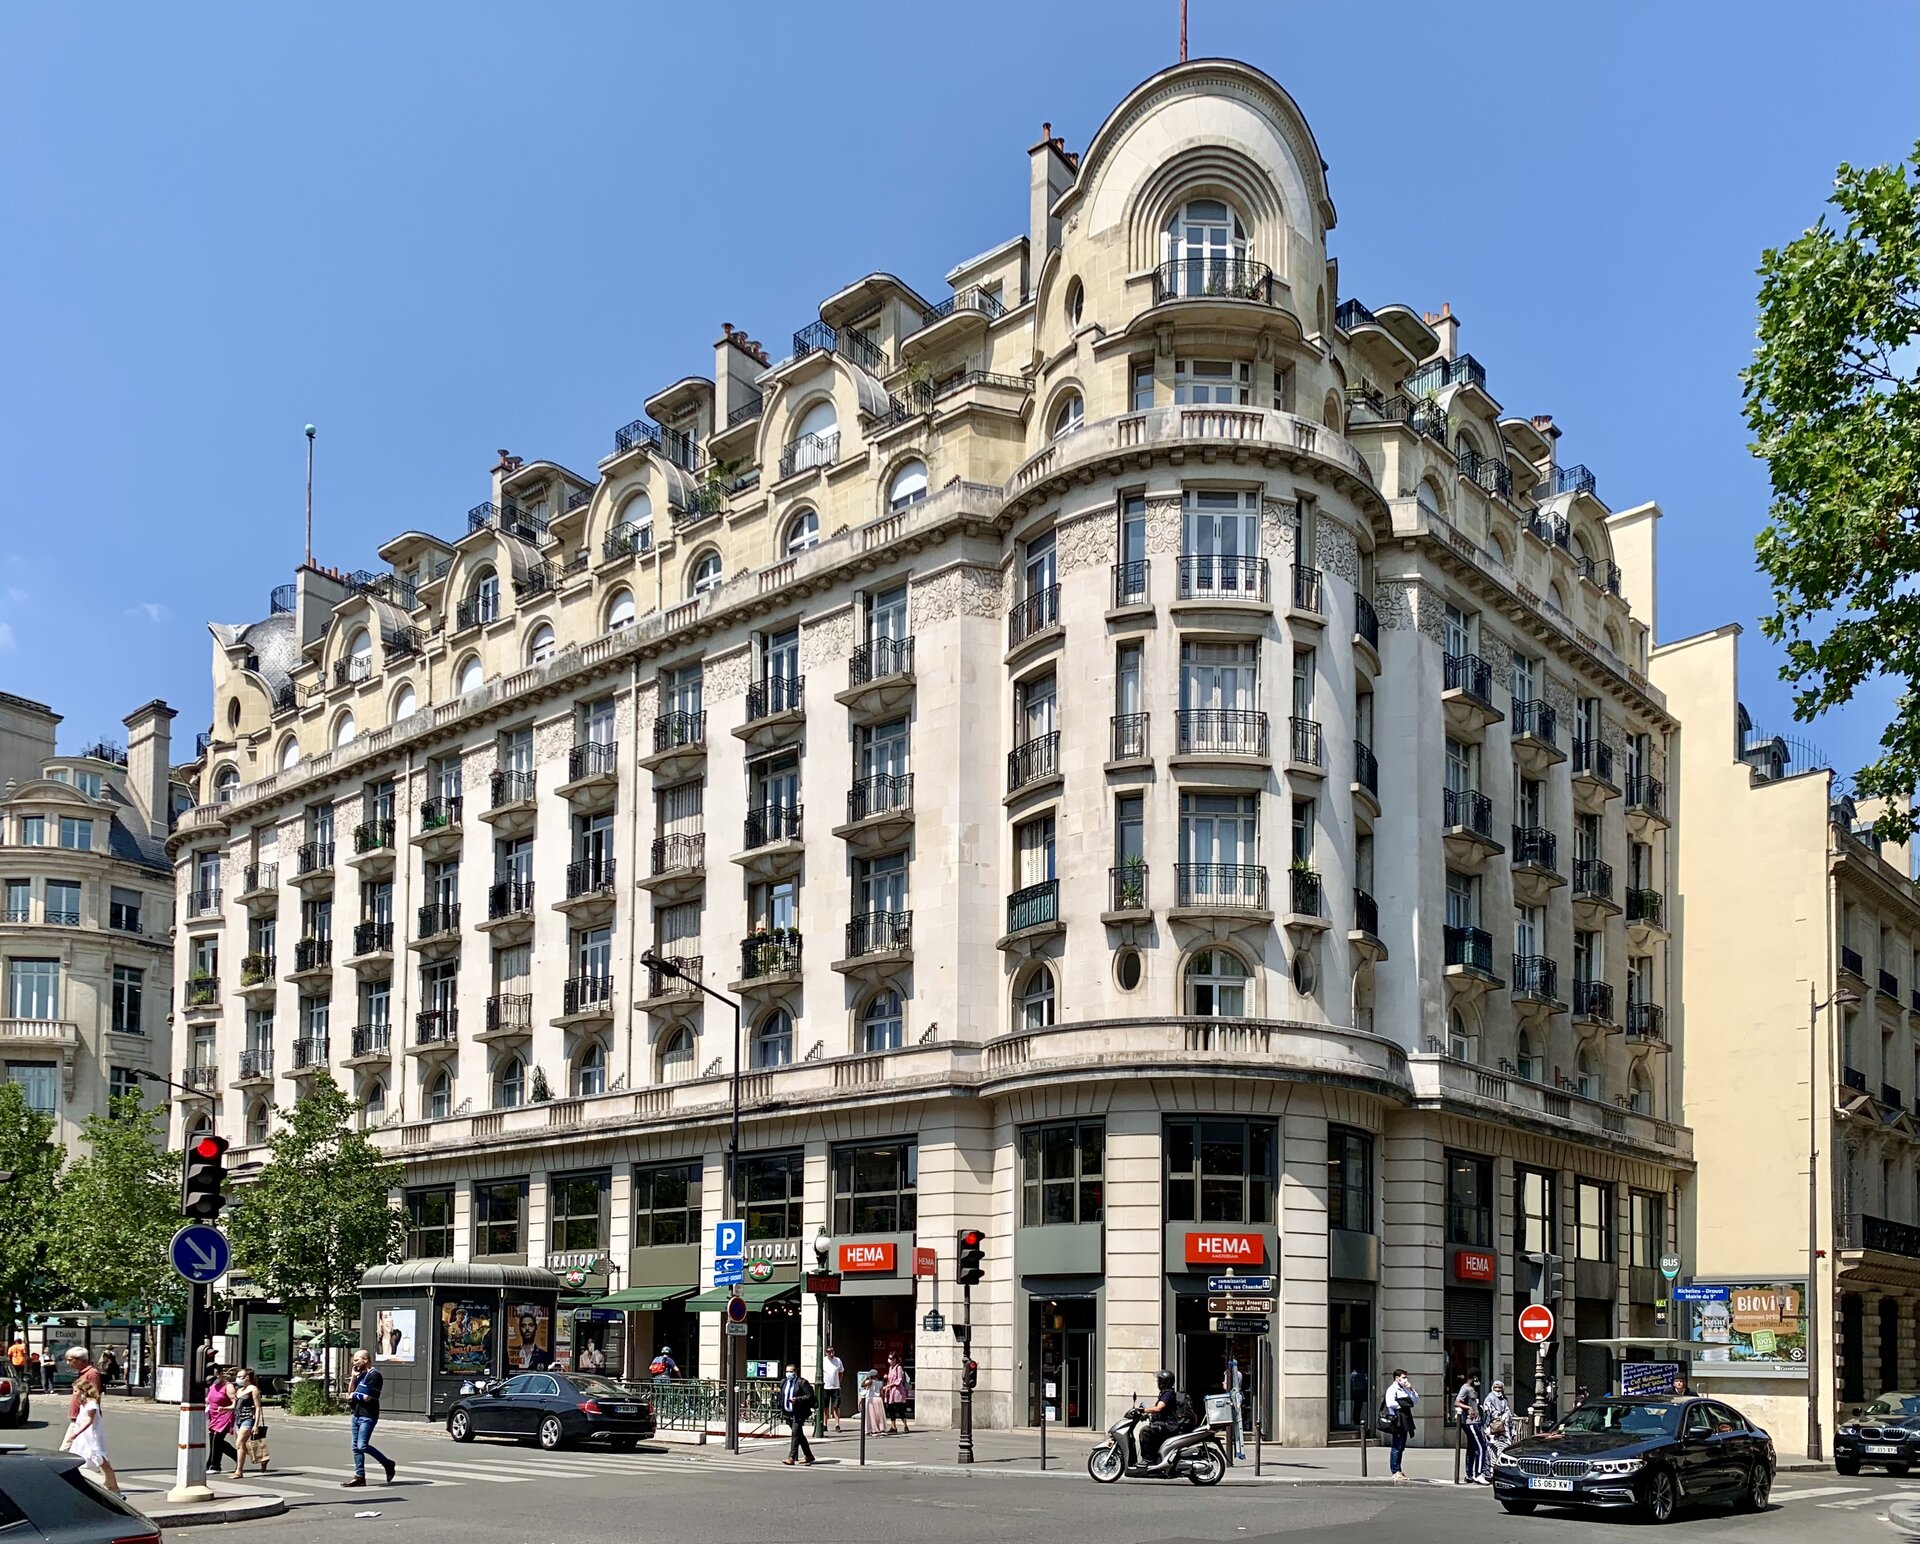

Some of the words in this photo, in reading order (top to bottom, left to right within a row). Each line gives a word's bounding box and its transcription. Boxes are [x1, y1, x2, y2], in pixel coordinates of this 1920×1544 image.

[722, 1228, 736, 1251] P
[1198, 1237, 1251, 1254] HEMA
[847, 1247, 884, 1262] HEMA
[918, 1257, 935, 1266] HEMA
[1466, 1256, 1489, 1272] HEMA
[1662, 1258, 1678, 1267] BUS
